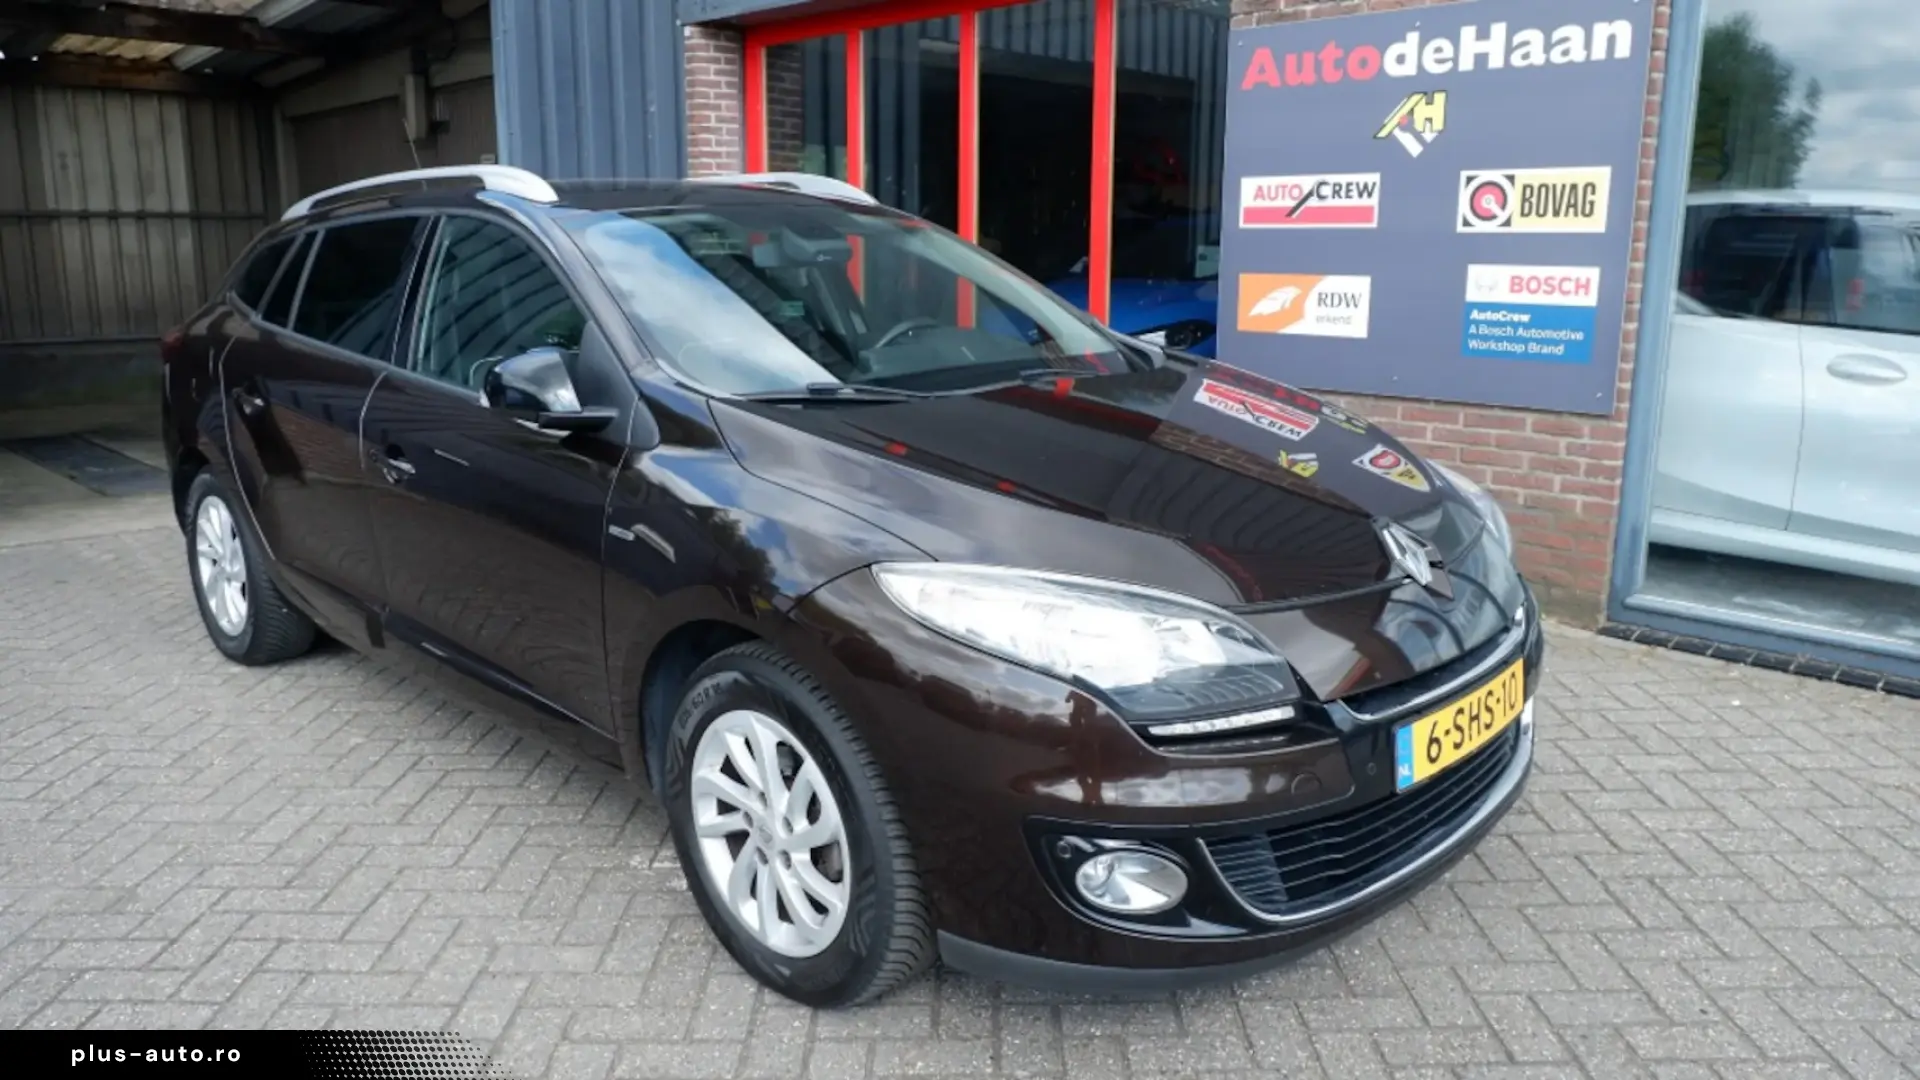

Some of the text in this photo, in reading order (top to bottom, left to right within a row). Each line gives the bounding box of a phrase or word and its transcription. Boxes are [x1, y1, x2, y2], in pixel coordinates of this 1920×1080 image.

[1253, 180, 1376, 202] AUTO CREW
[1520, 182, 1597, 218] BOVAG
[1509, 275, 1591, 297] BOSCH
[1317, 292, 1362, 309] RDW
[1470, 309, 1531, 323] AutoCrew
[1469, 324, 1584, 341] A Bosch Automotive
[1468, 339, 1565, 356] Workshop Brand
[1426, 671, 1518, 764] 6-SHS-10
